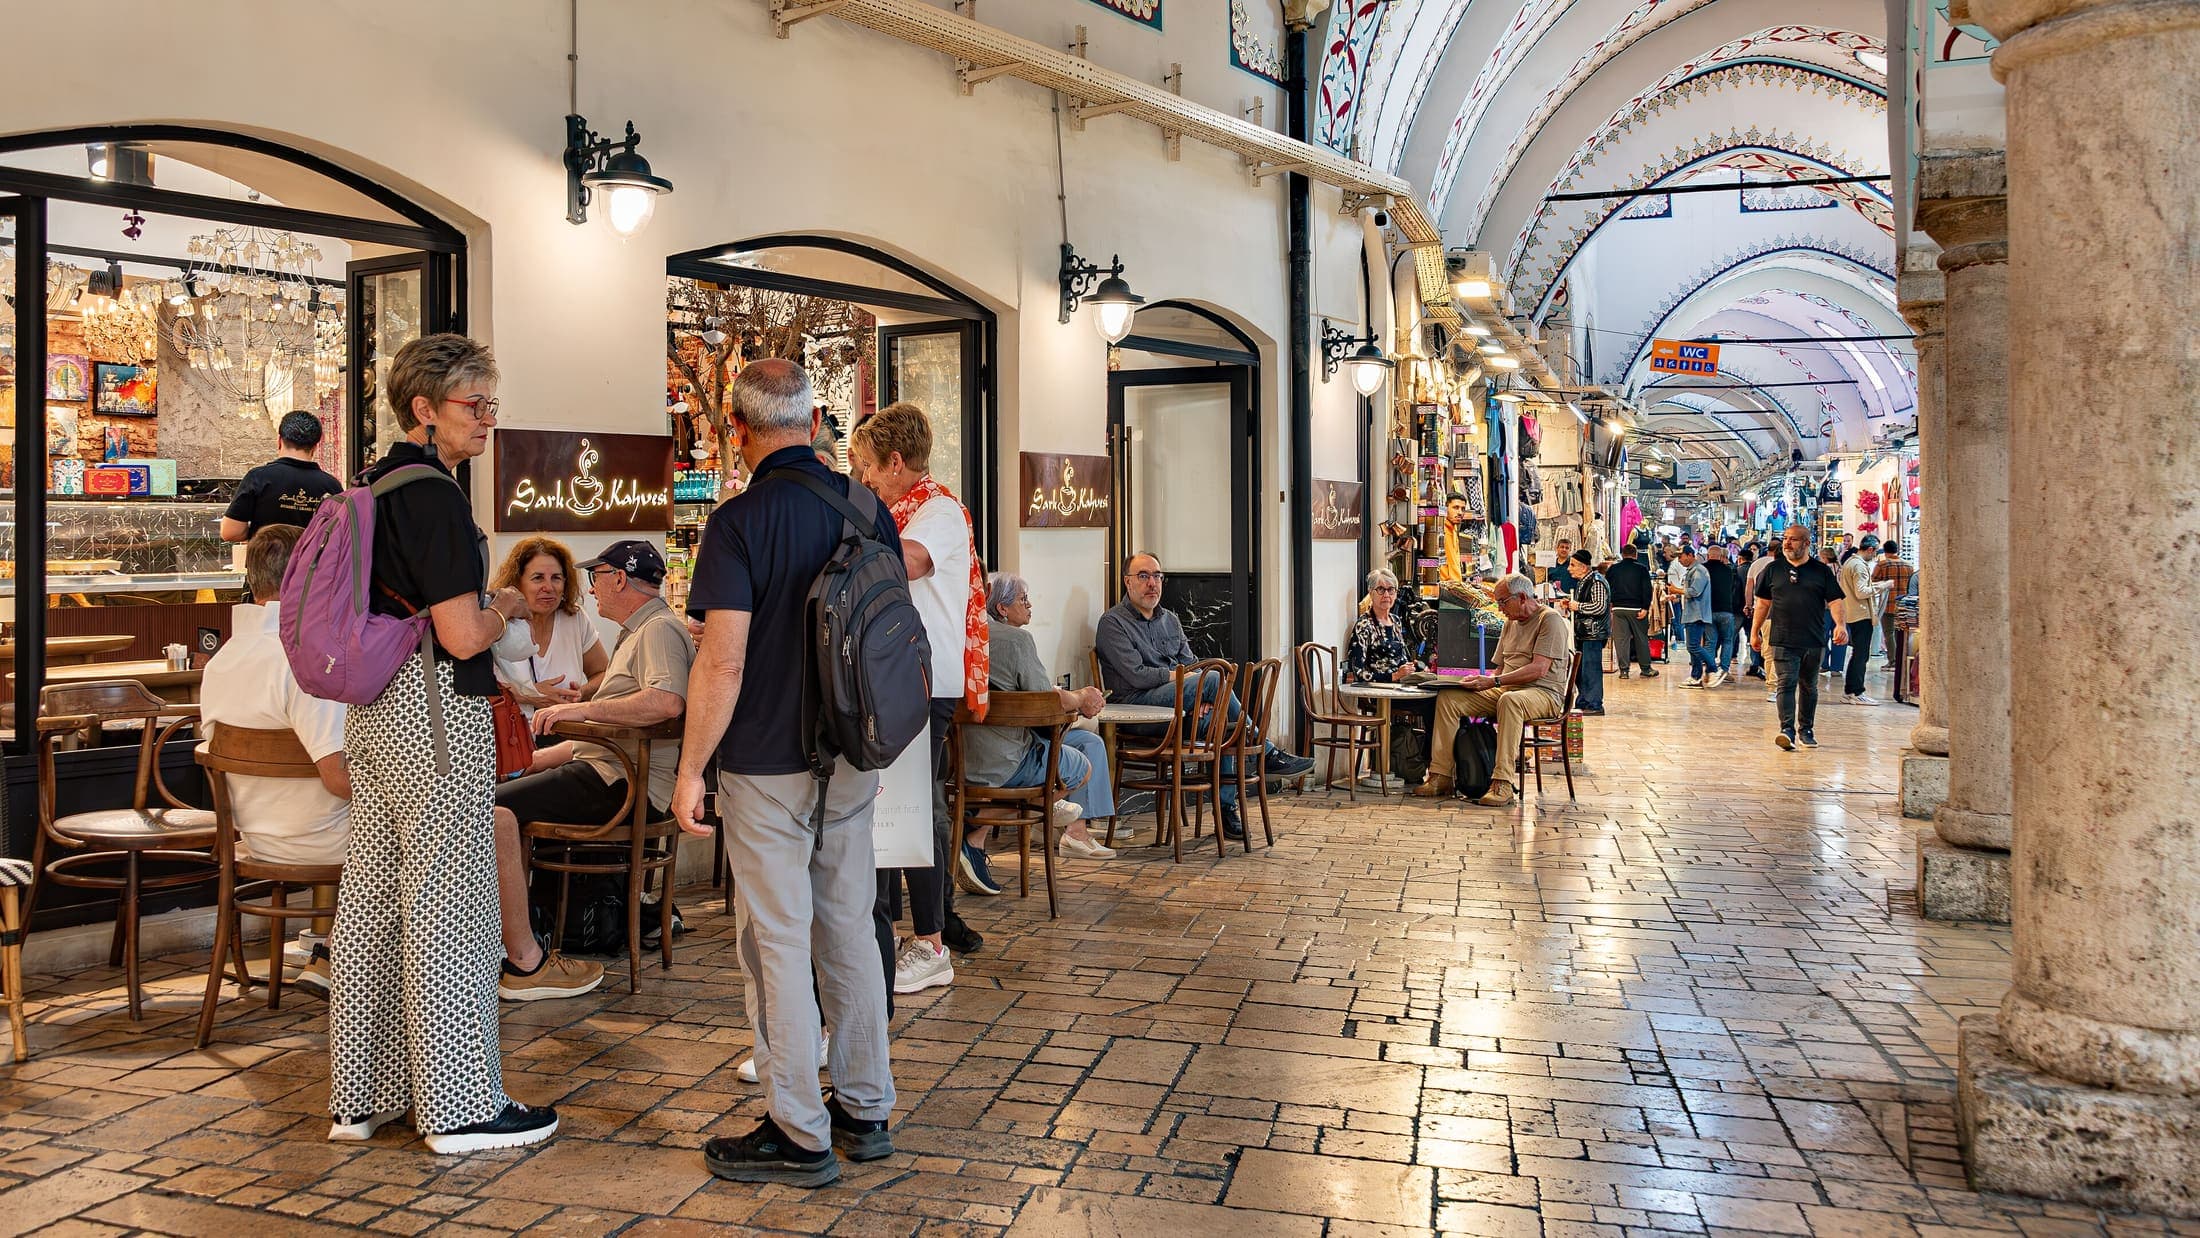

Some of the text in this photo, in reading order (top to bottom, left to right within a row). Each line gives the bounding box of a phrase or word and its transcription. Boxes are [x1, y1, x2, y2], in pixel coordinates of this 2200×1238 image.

[1683, 346, 1705, 358] WC
[507, 478, 668, 523] Şark Kahvesi
[1076, 487, 1109, 521] Kahvesi
[1312, 508, 1325, 525] ark
